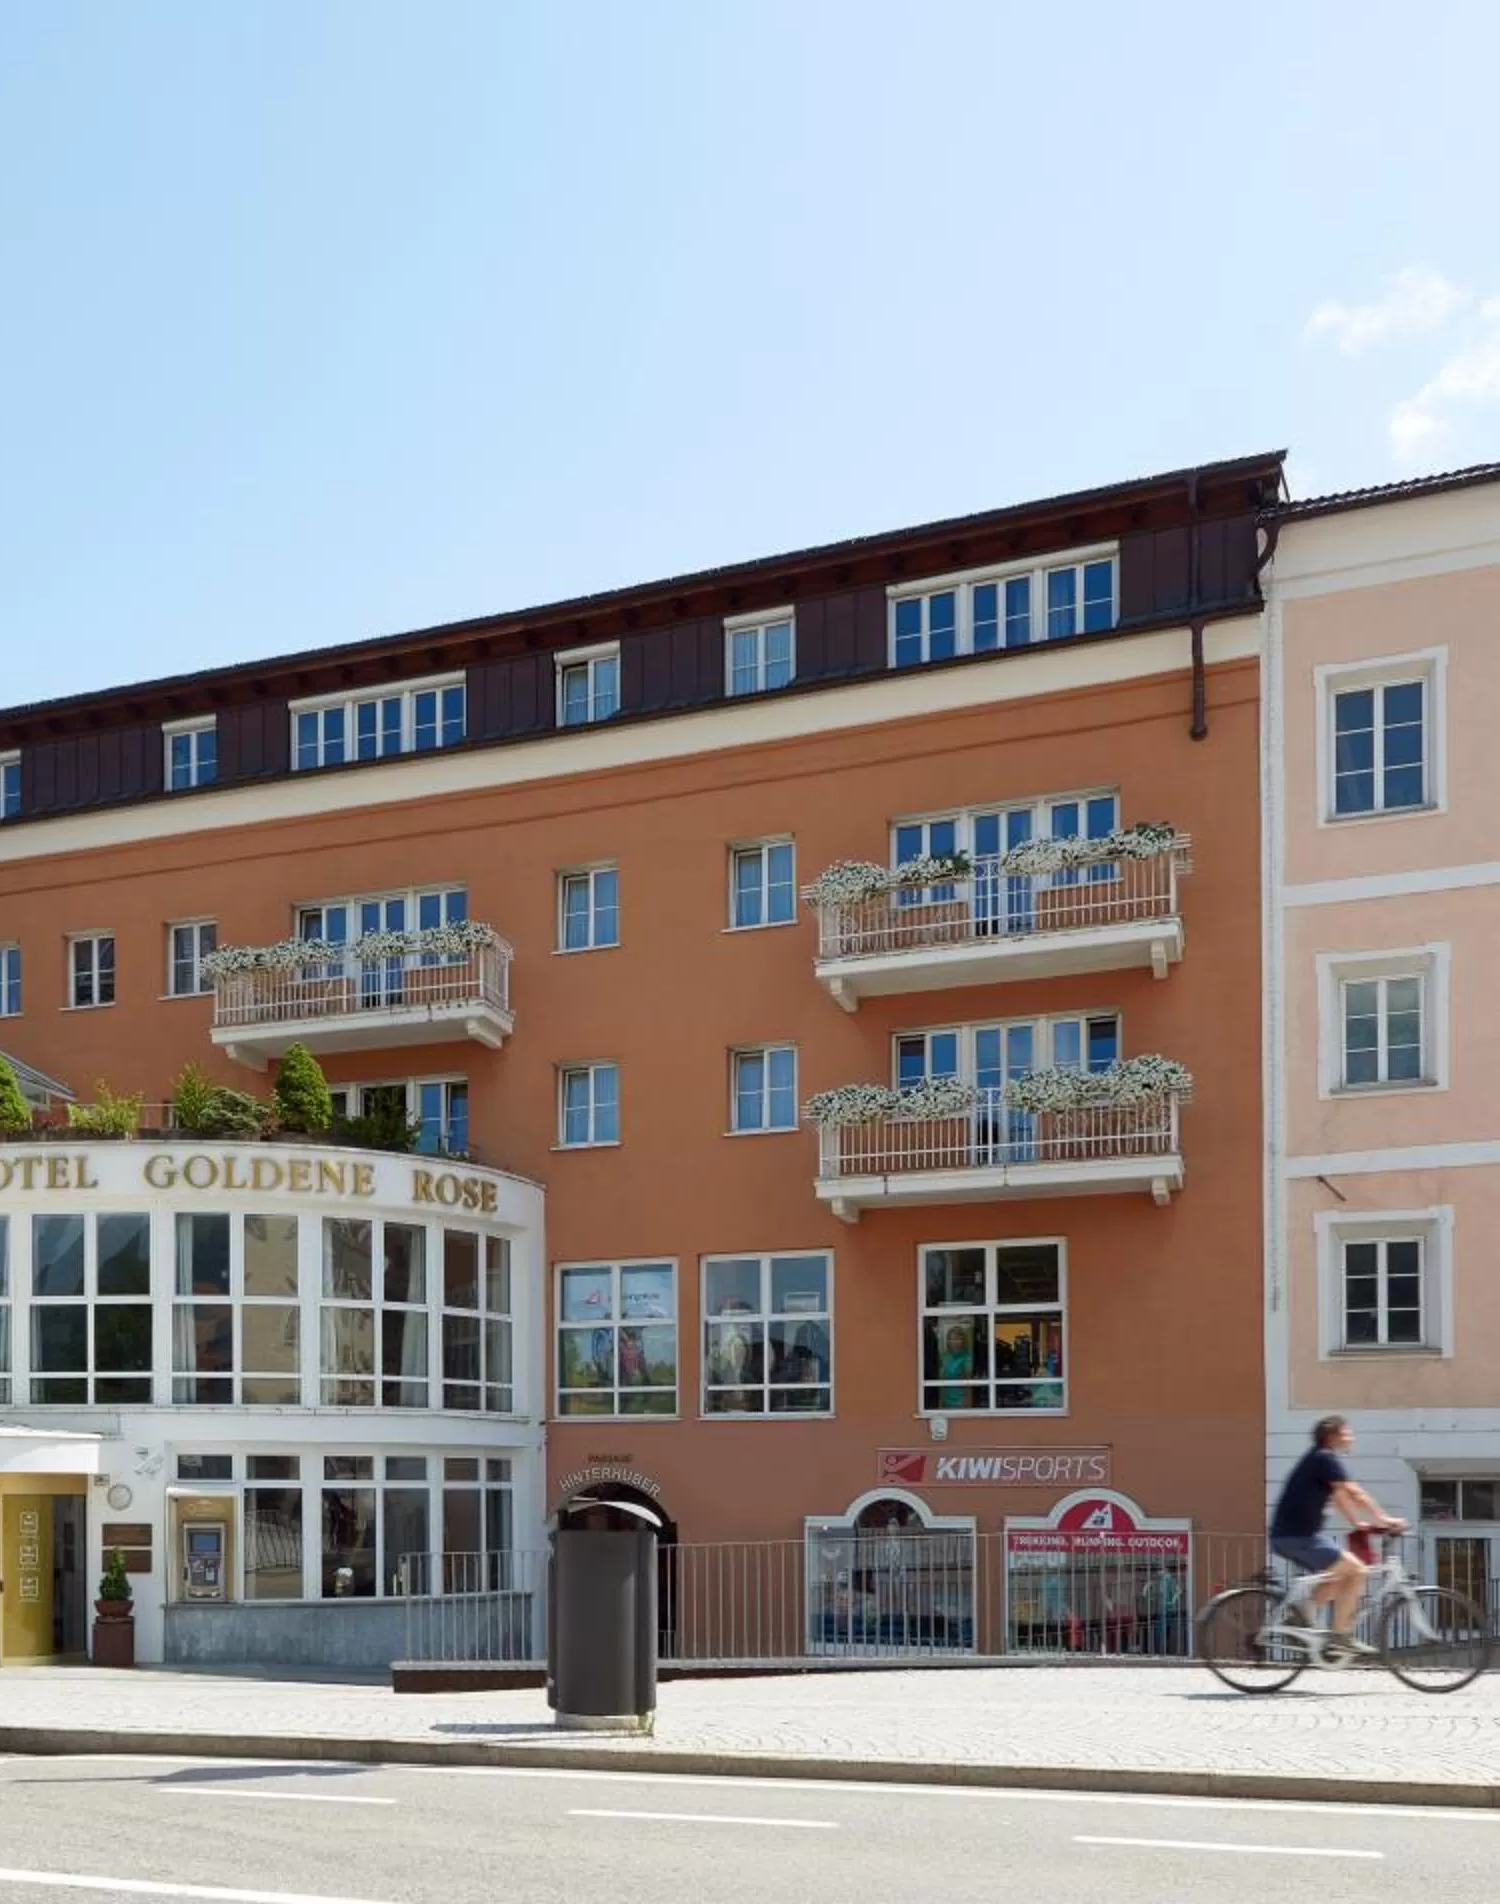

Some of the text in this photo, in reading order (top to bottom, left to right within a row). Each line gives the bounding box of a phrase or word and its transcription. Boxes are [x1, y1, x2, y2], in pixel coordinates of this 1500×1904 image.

[143, 1154, 376, 1197] GOLDENE
[411, 1168, 499, 1213] ROSE
[559, 1466, 661, 1498] HINTERHUBER
[936, 1455, 1107, 1481] KIWISPORTS
